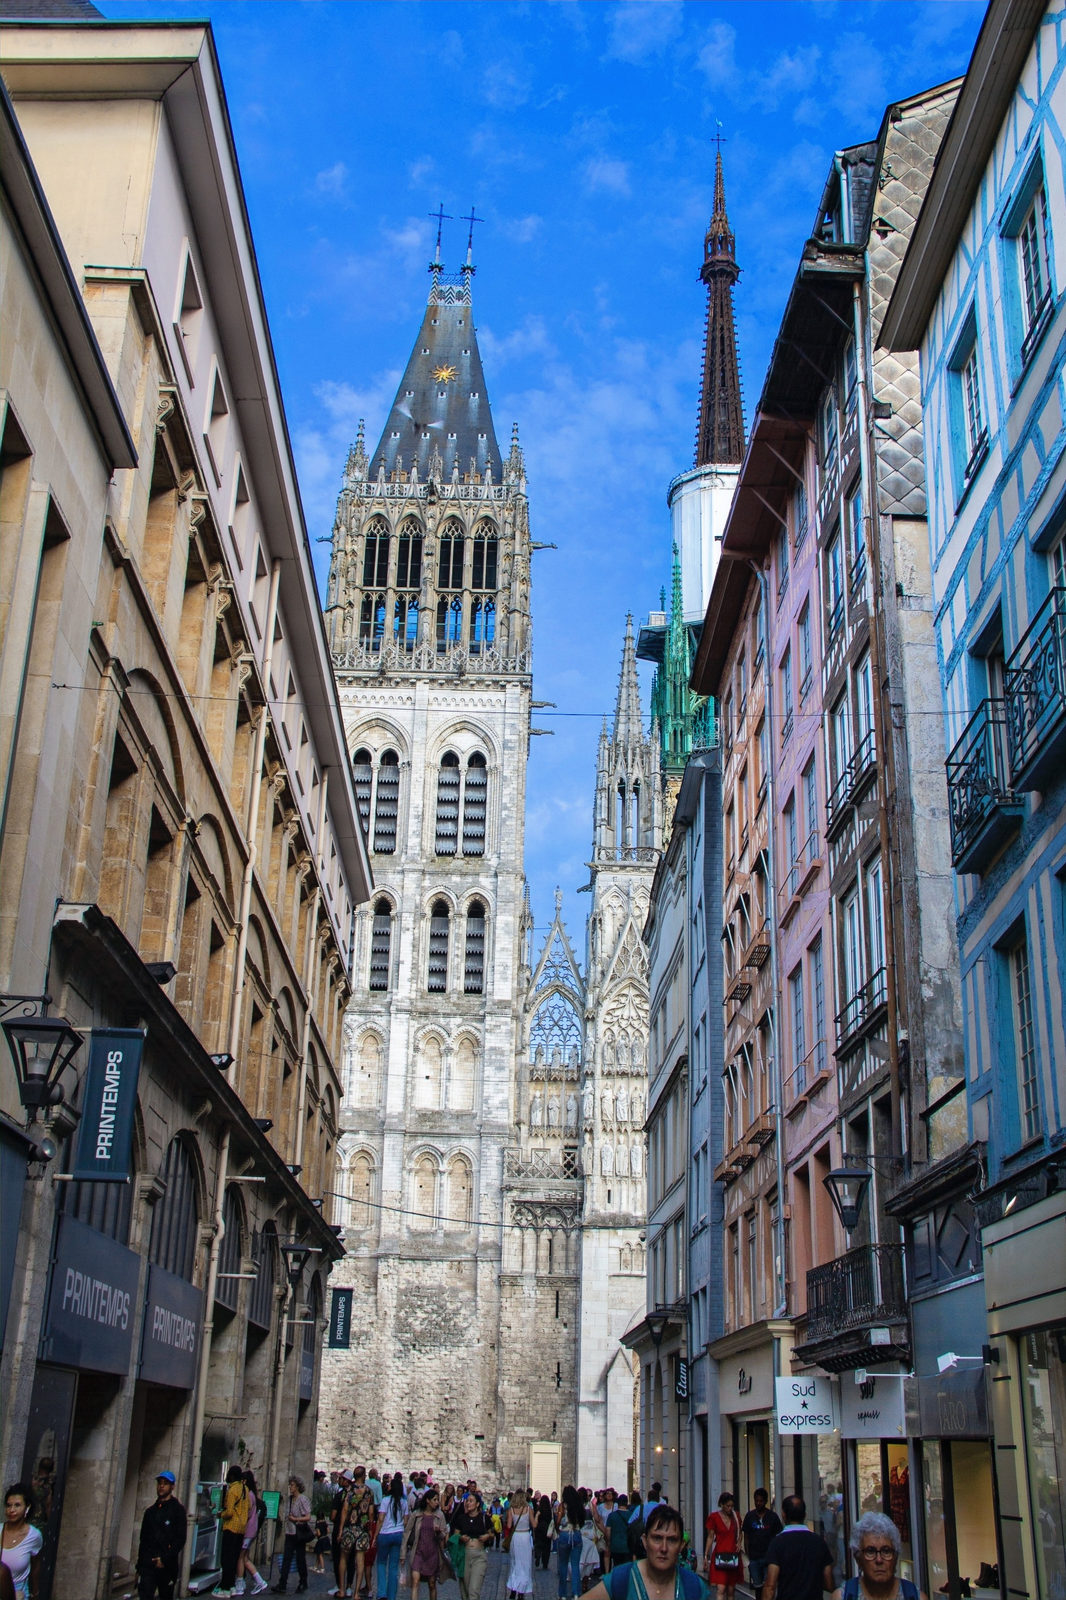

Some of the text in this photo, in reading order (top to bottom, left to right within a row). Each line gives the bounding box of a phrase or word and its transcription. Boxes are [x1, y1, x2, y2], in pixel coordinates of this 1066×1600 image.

[95, 1050, 123, 1160] PRINTEMPS
[62, 1267, 130, 1330] PRINTEMPS
[336, 1296, 346, 1340] PRINTEMPS
[152, 1305, 196, 1352] PRINTEMPS
[676, 1362, 688, 1398] Etam
[792, 1381, 816, 1397] Sud
[780, 1414, 831, 1430] express
